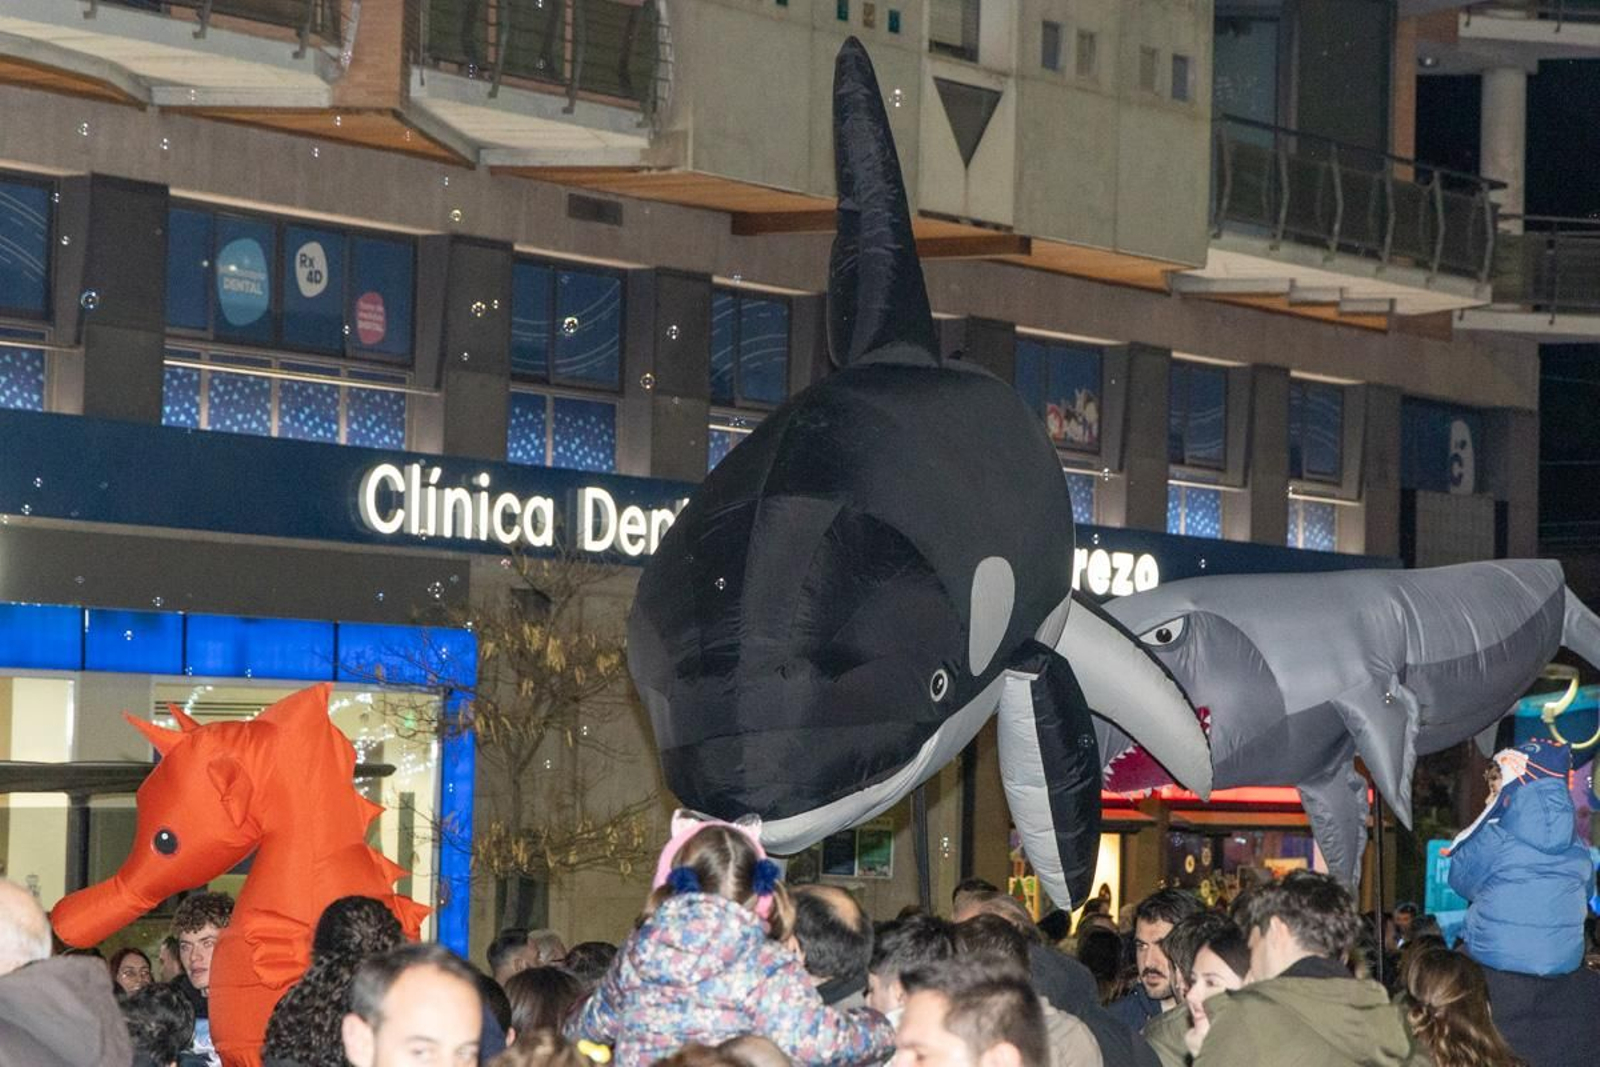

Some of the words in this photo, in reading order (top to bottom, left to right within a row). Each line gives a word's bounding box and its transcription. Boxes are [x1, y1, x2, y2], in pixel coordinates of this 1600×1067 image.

[299, 254, 314, 269] Rx
[306, 270, 323, 285] 4D
[360, 463, 554, 547] Clínica
[578, 487, 690, 556] Den
